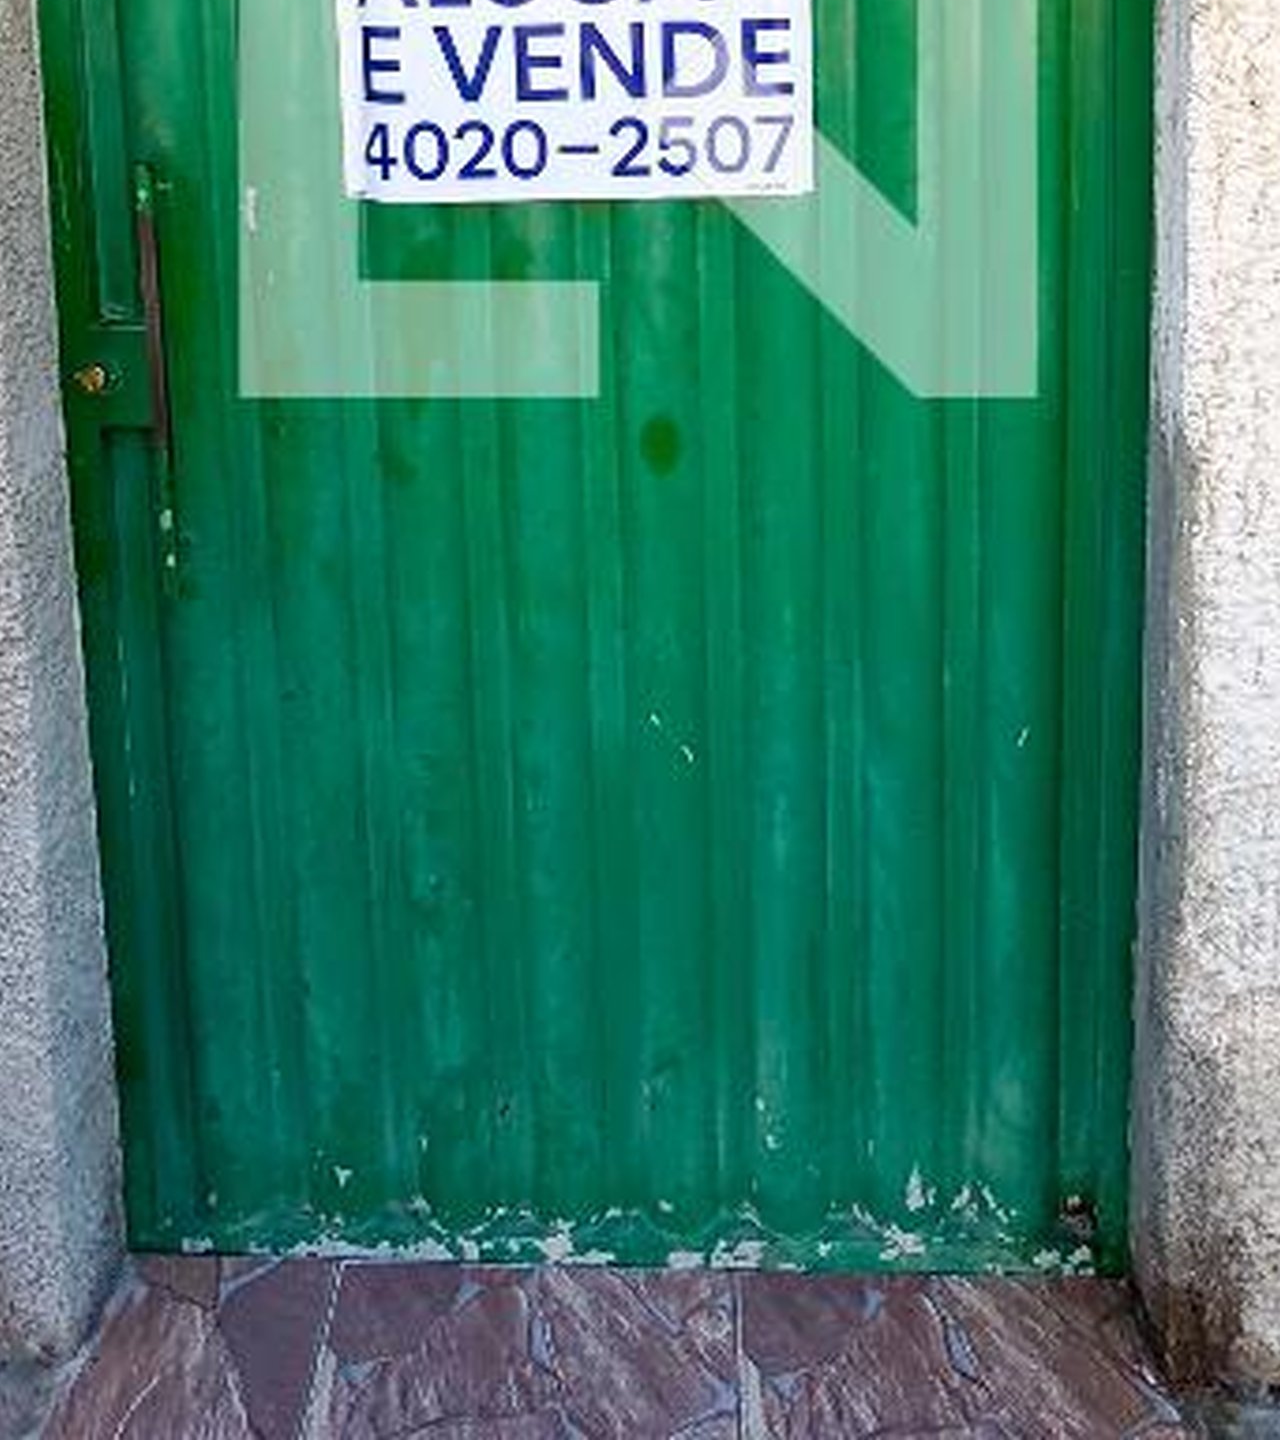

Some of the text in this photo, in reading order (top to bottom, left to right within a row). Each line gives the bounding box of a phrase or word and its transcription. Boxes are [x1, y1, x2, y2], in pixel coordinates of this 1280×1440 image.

[363, 17, 796, 105] E VENDE
[364, 115, 795, 182] 4020-2507
